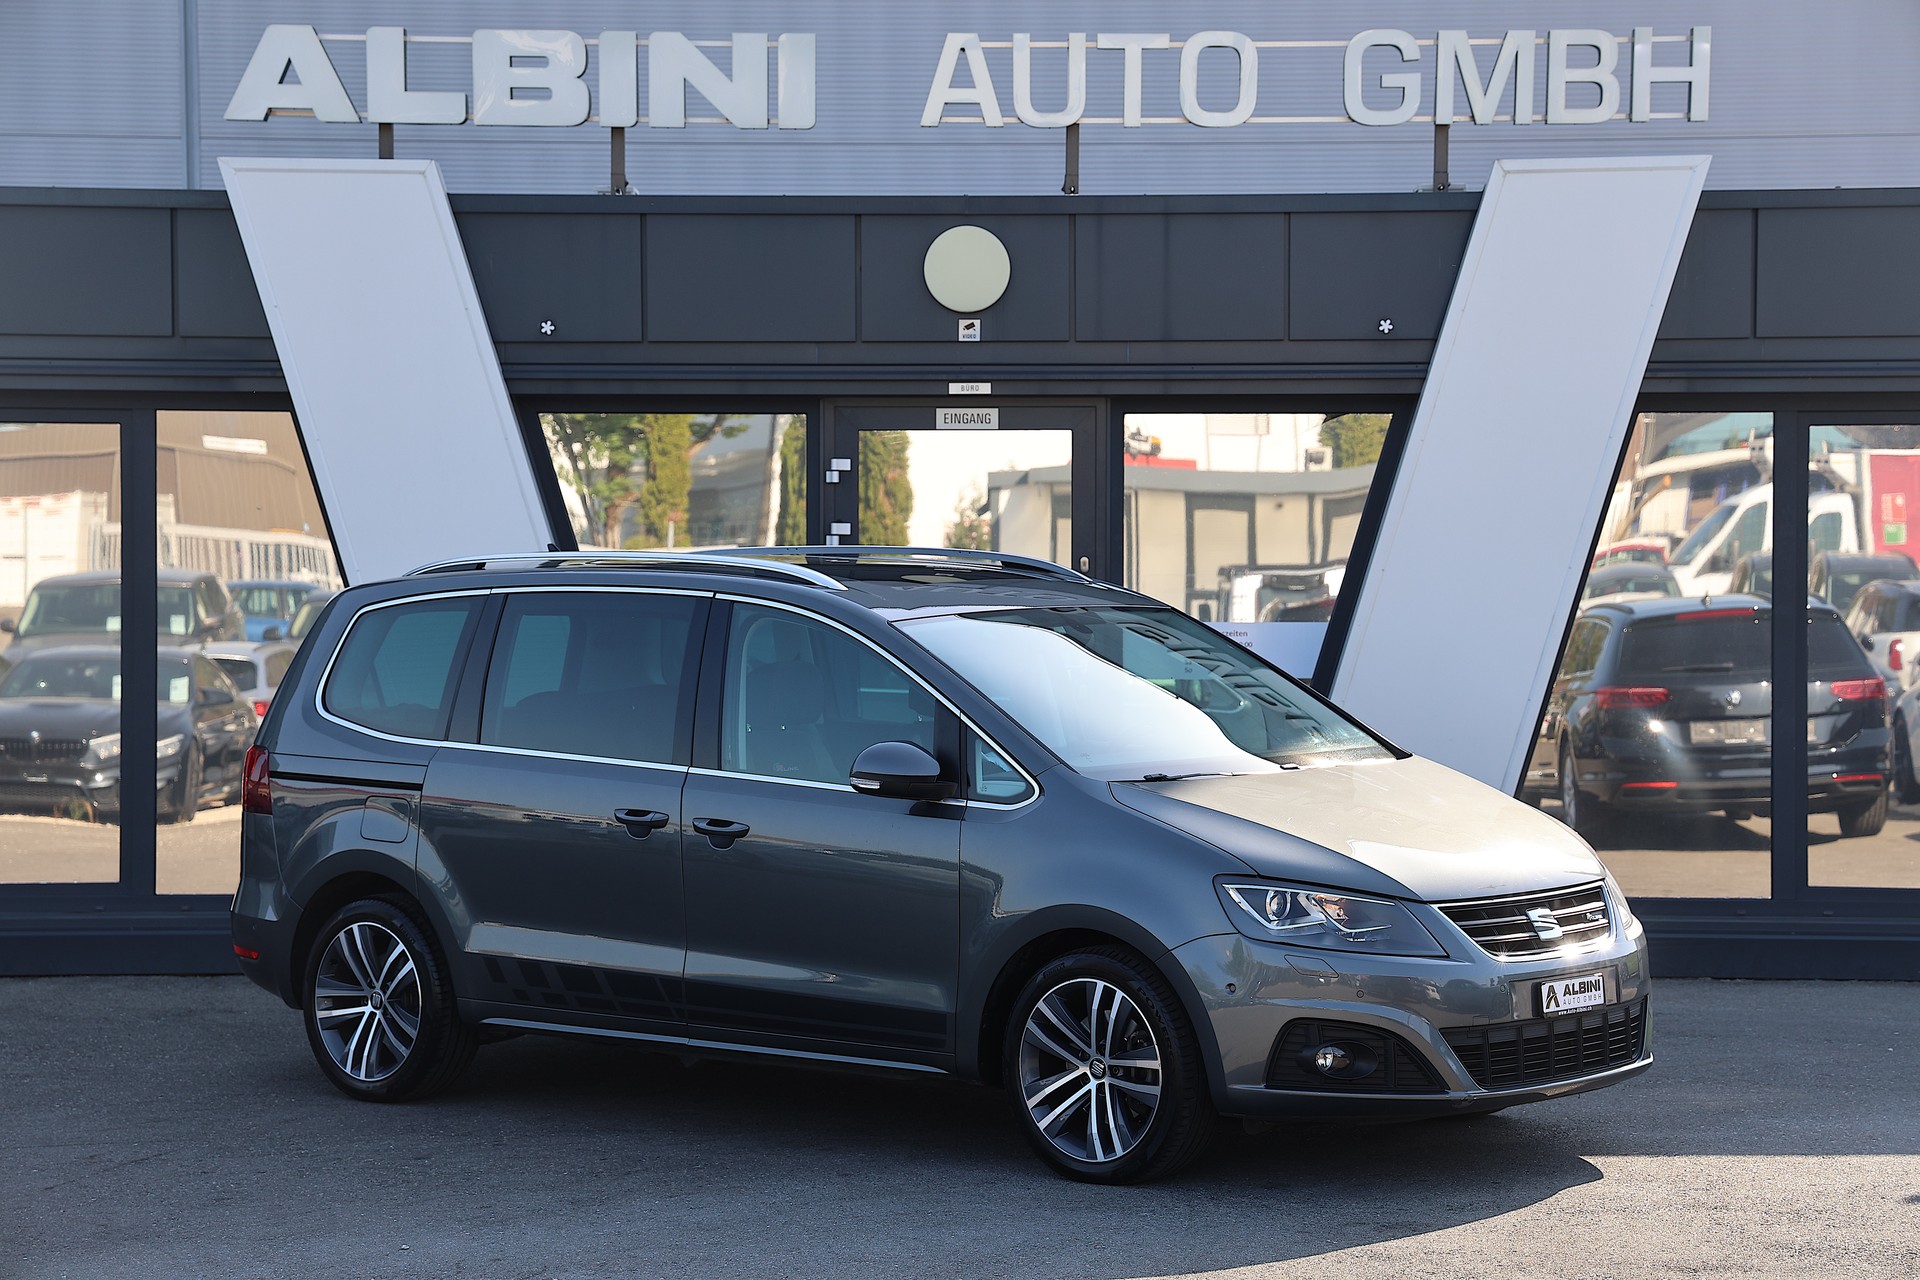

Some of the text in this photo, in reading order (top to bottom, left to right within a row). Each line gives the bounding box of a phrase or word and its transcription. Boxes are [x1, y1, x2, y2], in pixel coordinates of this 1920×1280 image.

[224, 24, 1712, 130] ALBINI AUTO GMBH
[960, 384, 980, 392] BÜRO
[943, 412, 992, 425] EINGANG
[1563, 978, 1601, 997] ALBINI
[1563, 993, 1602, 1006] AUTO GMBH
